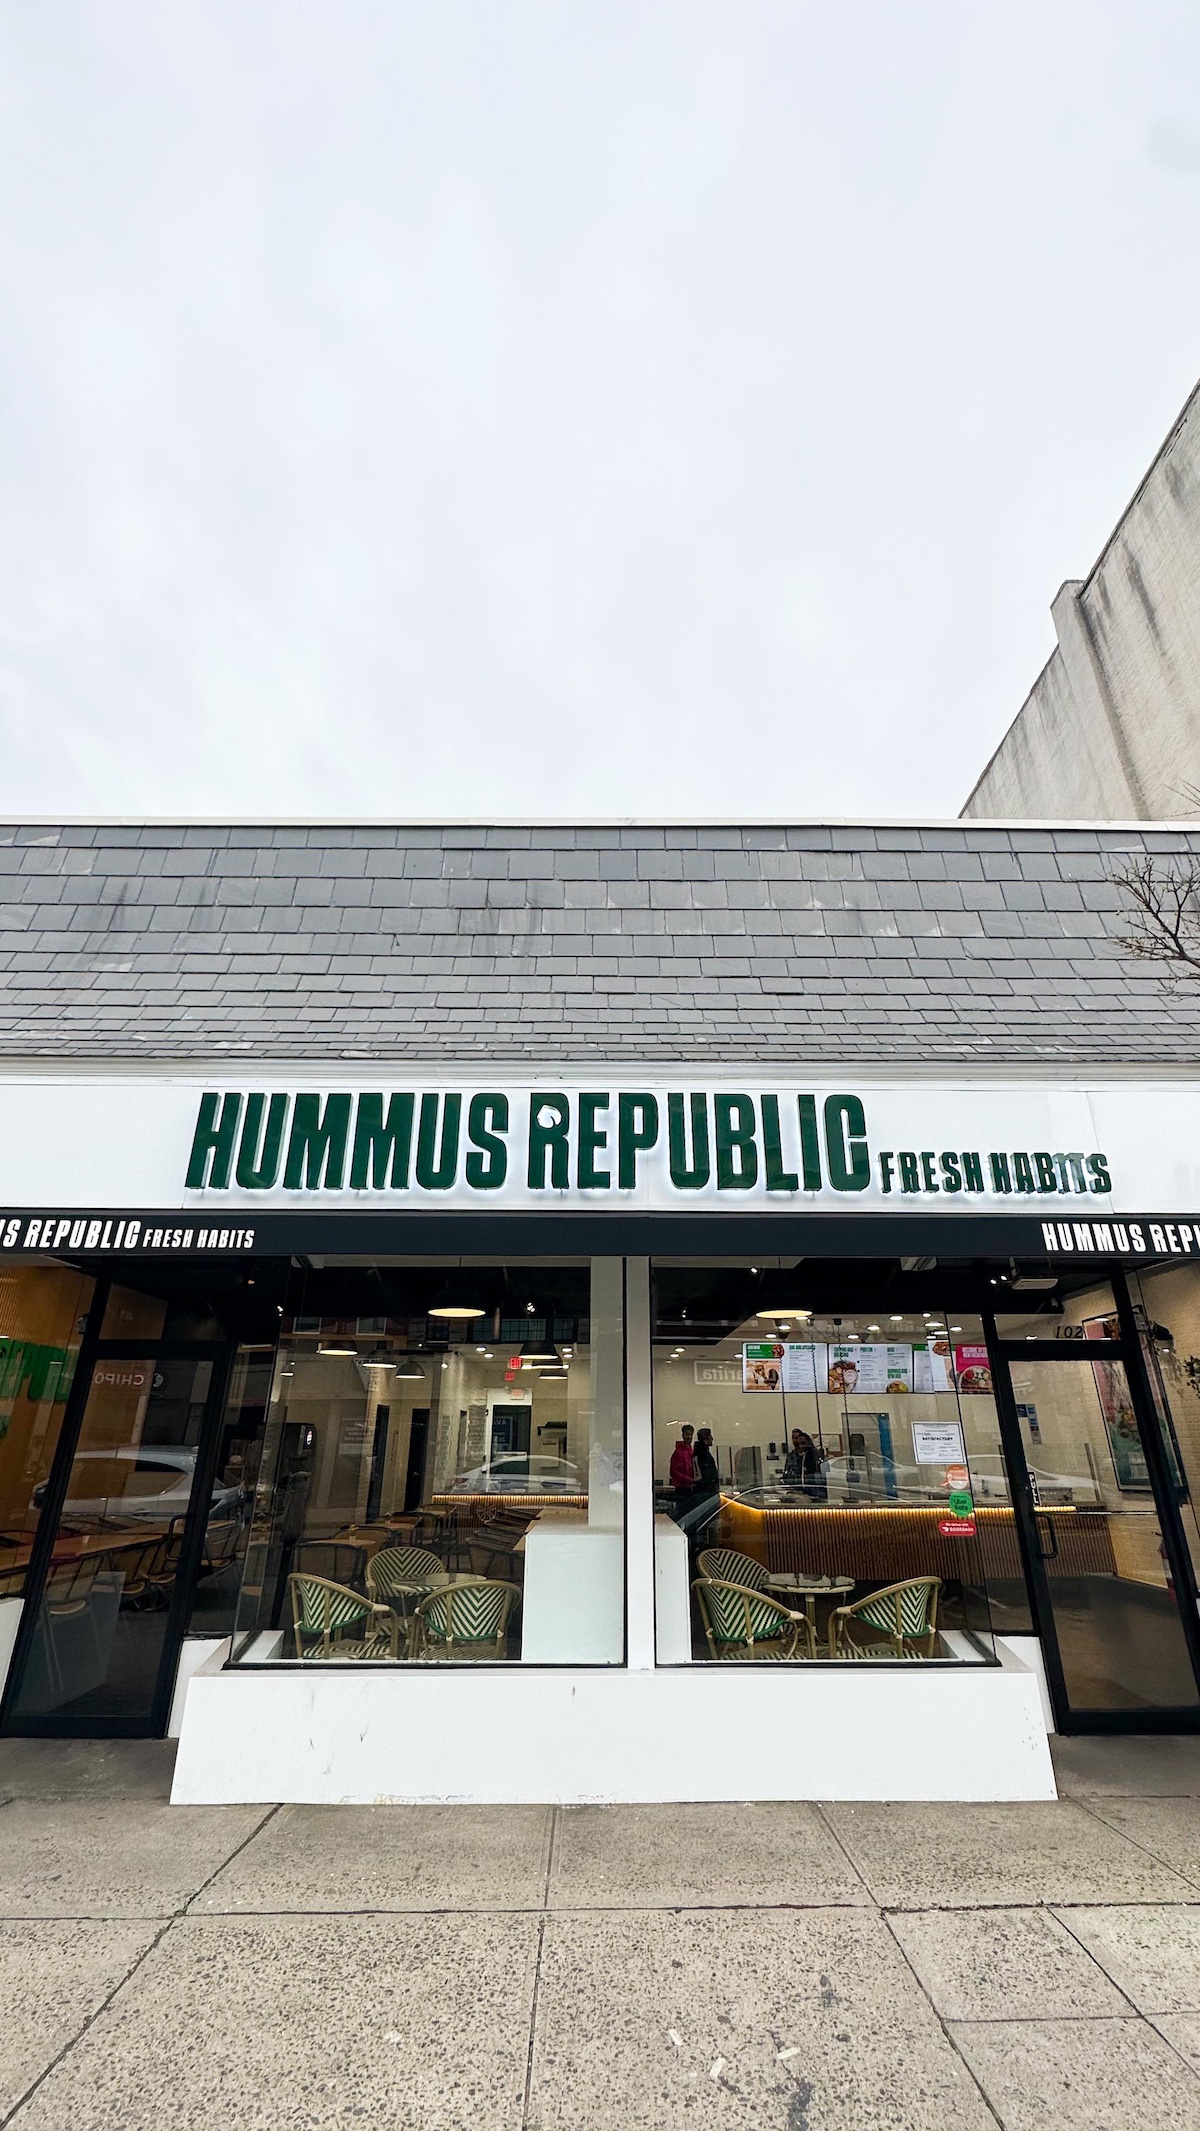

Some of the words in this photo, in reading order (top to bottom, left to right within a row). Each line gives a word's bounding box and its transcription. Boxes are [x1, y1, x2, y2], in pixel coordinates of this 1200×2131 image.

[184, 1092, 509, 1190] HUMMUS
[527, 1092, 871, 1191] REPUBLIC
[878, 1152, 985, 1194] FRESH
[988, 1152, 1112, 1195] HABITS
[23, 1219, 141, 1249] REPUBLIC
[142, 1229, 194, 1248] FRESH
[197, 1229, 255, 1249] HABITS
[1041, 1223, 1147, 1252] HUMMUS
[1056, 1326, 1083, 1339] 102
[1028, 1473, 1039, 1504] PULL
